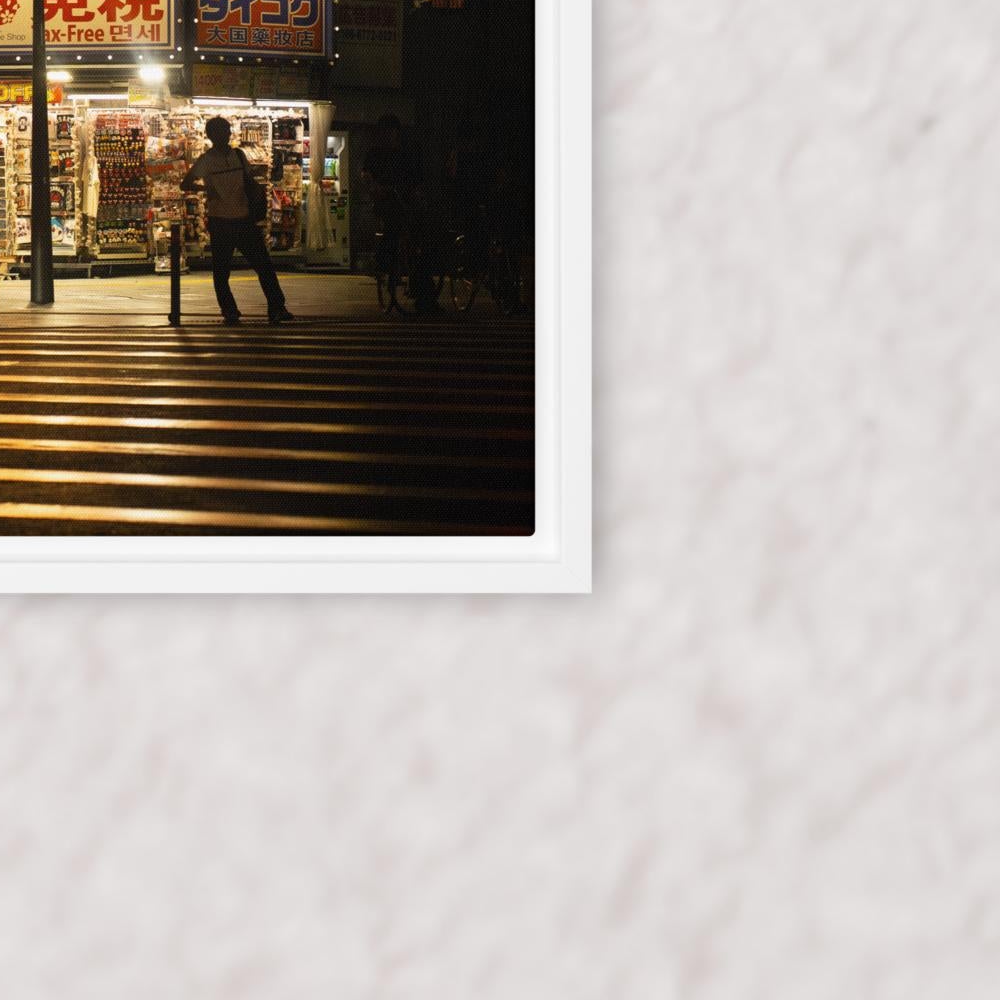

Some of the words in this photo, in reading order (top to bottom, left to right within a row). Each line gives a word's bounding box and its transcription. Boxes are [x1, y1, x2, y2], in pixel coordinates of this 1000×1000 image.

[7, 33, 26, 42] Shop
[32, 24, 105, 43] ax-Free
[110, 24, 161, 42] 면세
